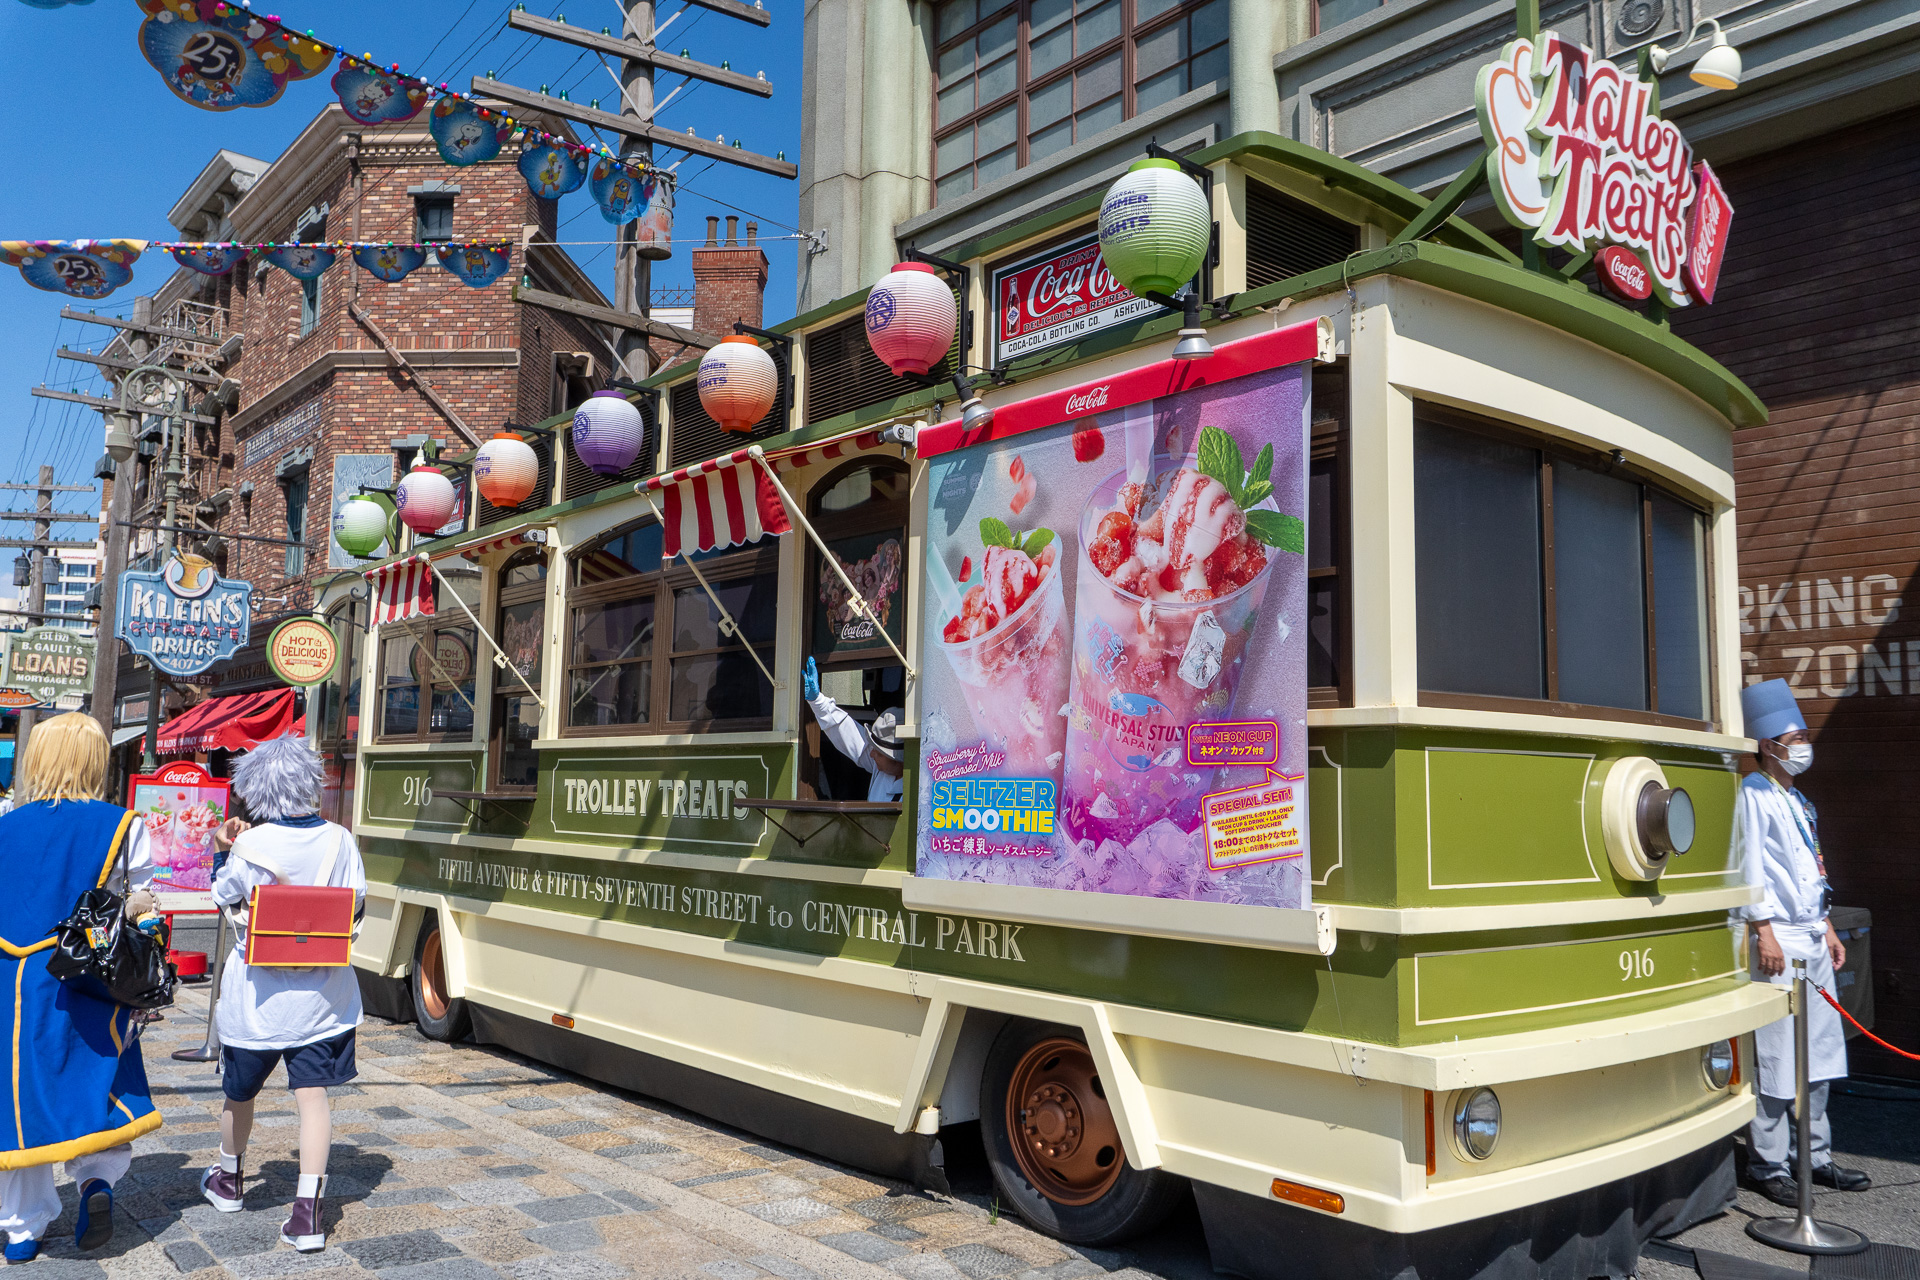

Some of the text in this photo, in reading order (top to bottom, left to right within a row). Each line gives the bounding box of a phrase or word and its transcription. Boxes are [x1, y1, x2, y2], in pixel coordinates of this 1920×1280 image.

[182, 32, 243, 85] 25th
[1545, 38, 1693, 222] Trolley
[1551, 134, 1684, 280] Treats
[1692, 183, 1721, 288] Coca-Cola
[1057, 247, 1098, 270] DRINK
[1026, 251, 1123, 318] Coca-Co
[1610, 255, 1646, 293] Coca-Cola
[1023, 289, 1135, 333] DELICIOUS AND REFRES
[1008, 334, 1048, 353] COCA-COLA
[1049, 320, 1086, 340] BOTTLING
[1088, 316, 1101, 327] CO.
[1065, 385, 1111, 415] Coca-Cola
[130, 582, 243, 625] KLEIN'S
[1738, 574, 1903, 636] RKING
[289, 636, 322, 647] HOT &
[840, 621, 875, 640] Coca-Cola
[21, 642, 83, 655] B. GAULT'S
[151, 636, 217, 657] DRUGS
[281, 645, 328, 660] DELICIOUS
[12, 651, 88, 677] LOANS
[169, 658, 194, 670] 407
[16, 673, 68, 685] MORTGAGE
[170, 675, 213, 684] WATER ST.
[1082, 691, 1143, 738] UNIVERSAL
[1147, 724, 1186, 742] STUD
[1213, 731, 1246, 744] NEON
[1247, 730, 1273, 743] CUP
[928, 740, 986, 769] Strawberry &
[163, 770, 202, 784] Coca-Cola
[932, 758, 980, 781] Condensed
[402, 775, 434, 807] 916
[564, 778, 750, 822] TROLLEY TREATS
[932, 779, 1056, 810] SELTZER
[1210, 786, 1293, 816] SPECIAL SET!
[932, 808, 1054, 833] SMOOTHIE
[1211, 816, 1238, 827] AVAILABLE
[1238, 814, 1254, 822] UNTIL
[1279, 805, 1294, 814] ONLY
[1217, 824, 1232, 832] NEON
[1248, 818, 1266, 827] DRINK
[1269, 813, 1289, 822] LARGE
[1238, 826, 1255, 834] DRINK
[1255, 820, 1282, 831] VOUCHER
[438, 857, 1026, 963] FIFTH AVENUE & FIFTY-SEVENTH STREET to CENTRAL PARK
[1618, 947, 1655, 982] 916
